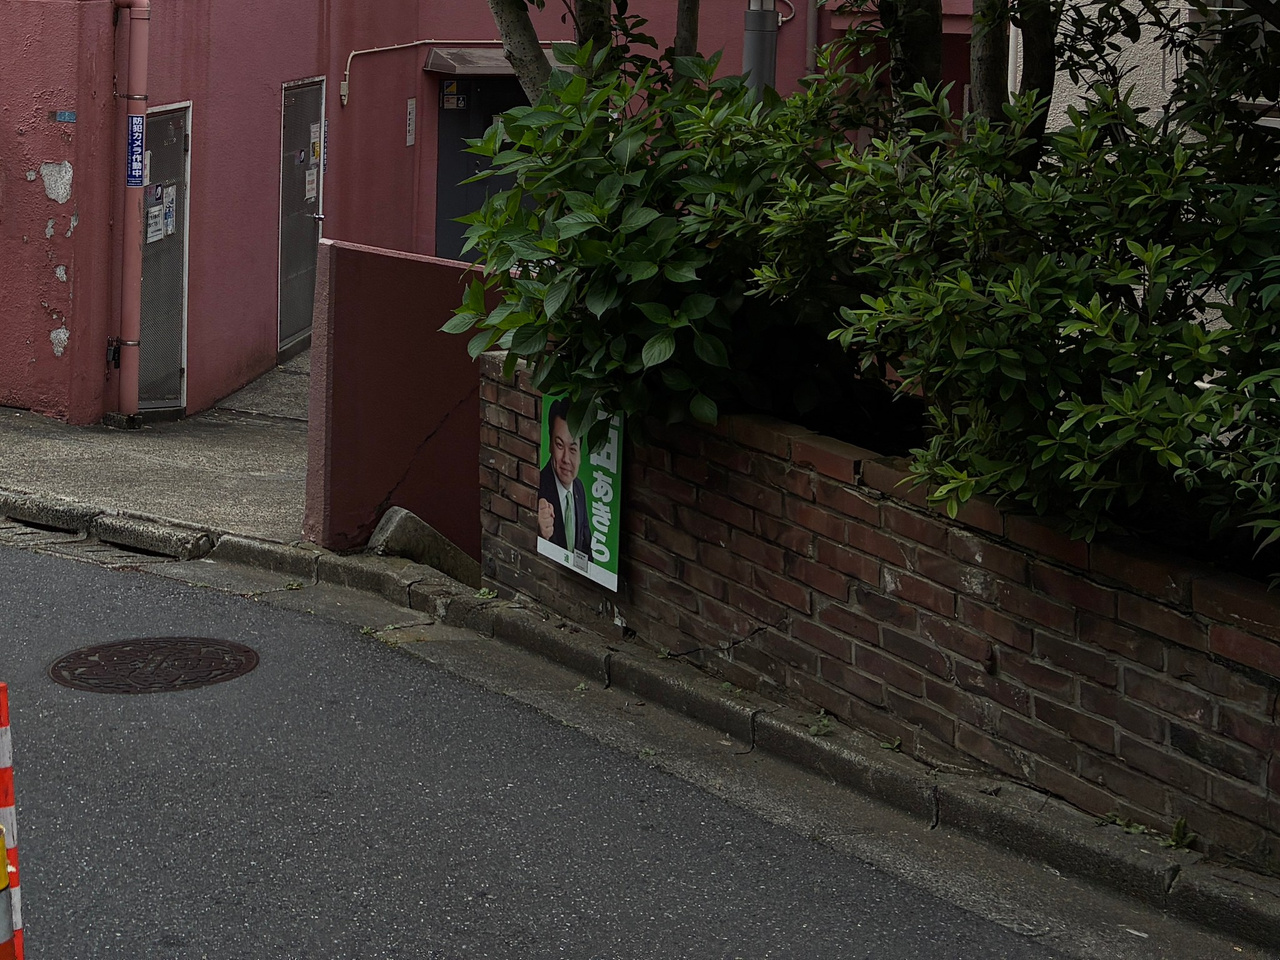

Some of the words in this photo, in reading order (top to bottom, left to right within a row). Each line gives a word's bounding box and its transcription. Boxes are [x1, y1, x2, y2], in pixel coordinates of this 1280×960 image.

[132, 116, 143, 178] 防犯カメラ作動中
[589, 397, 620, 563] 田あきら
